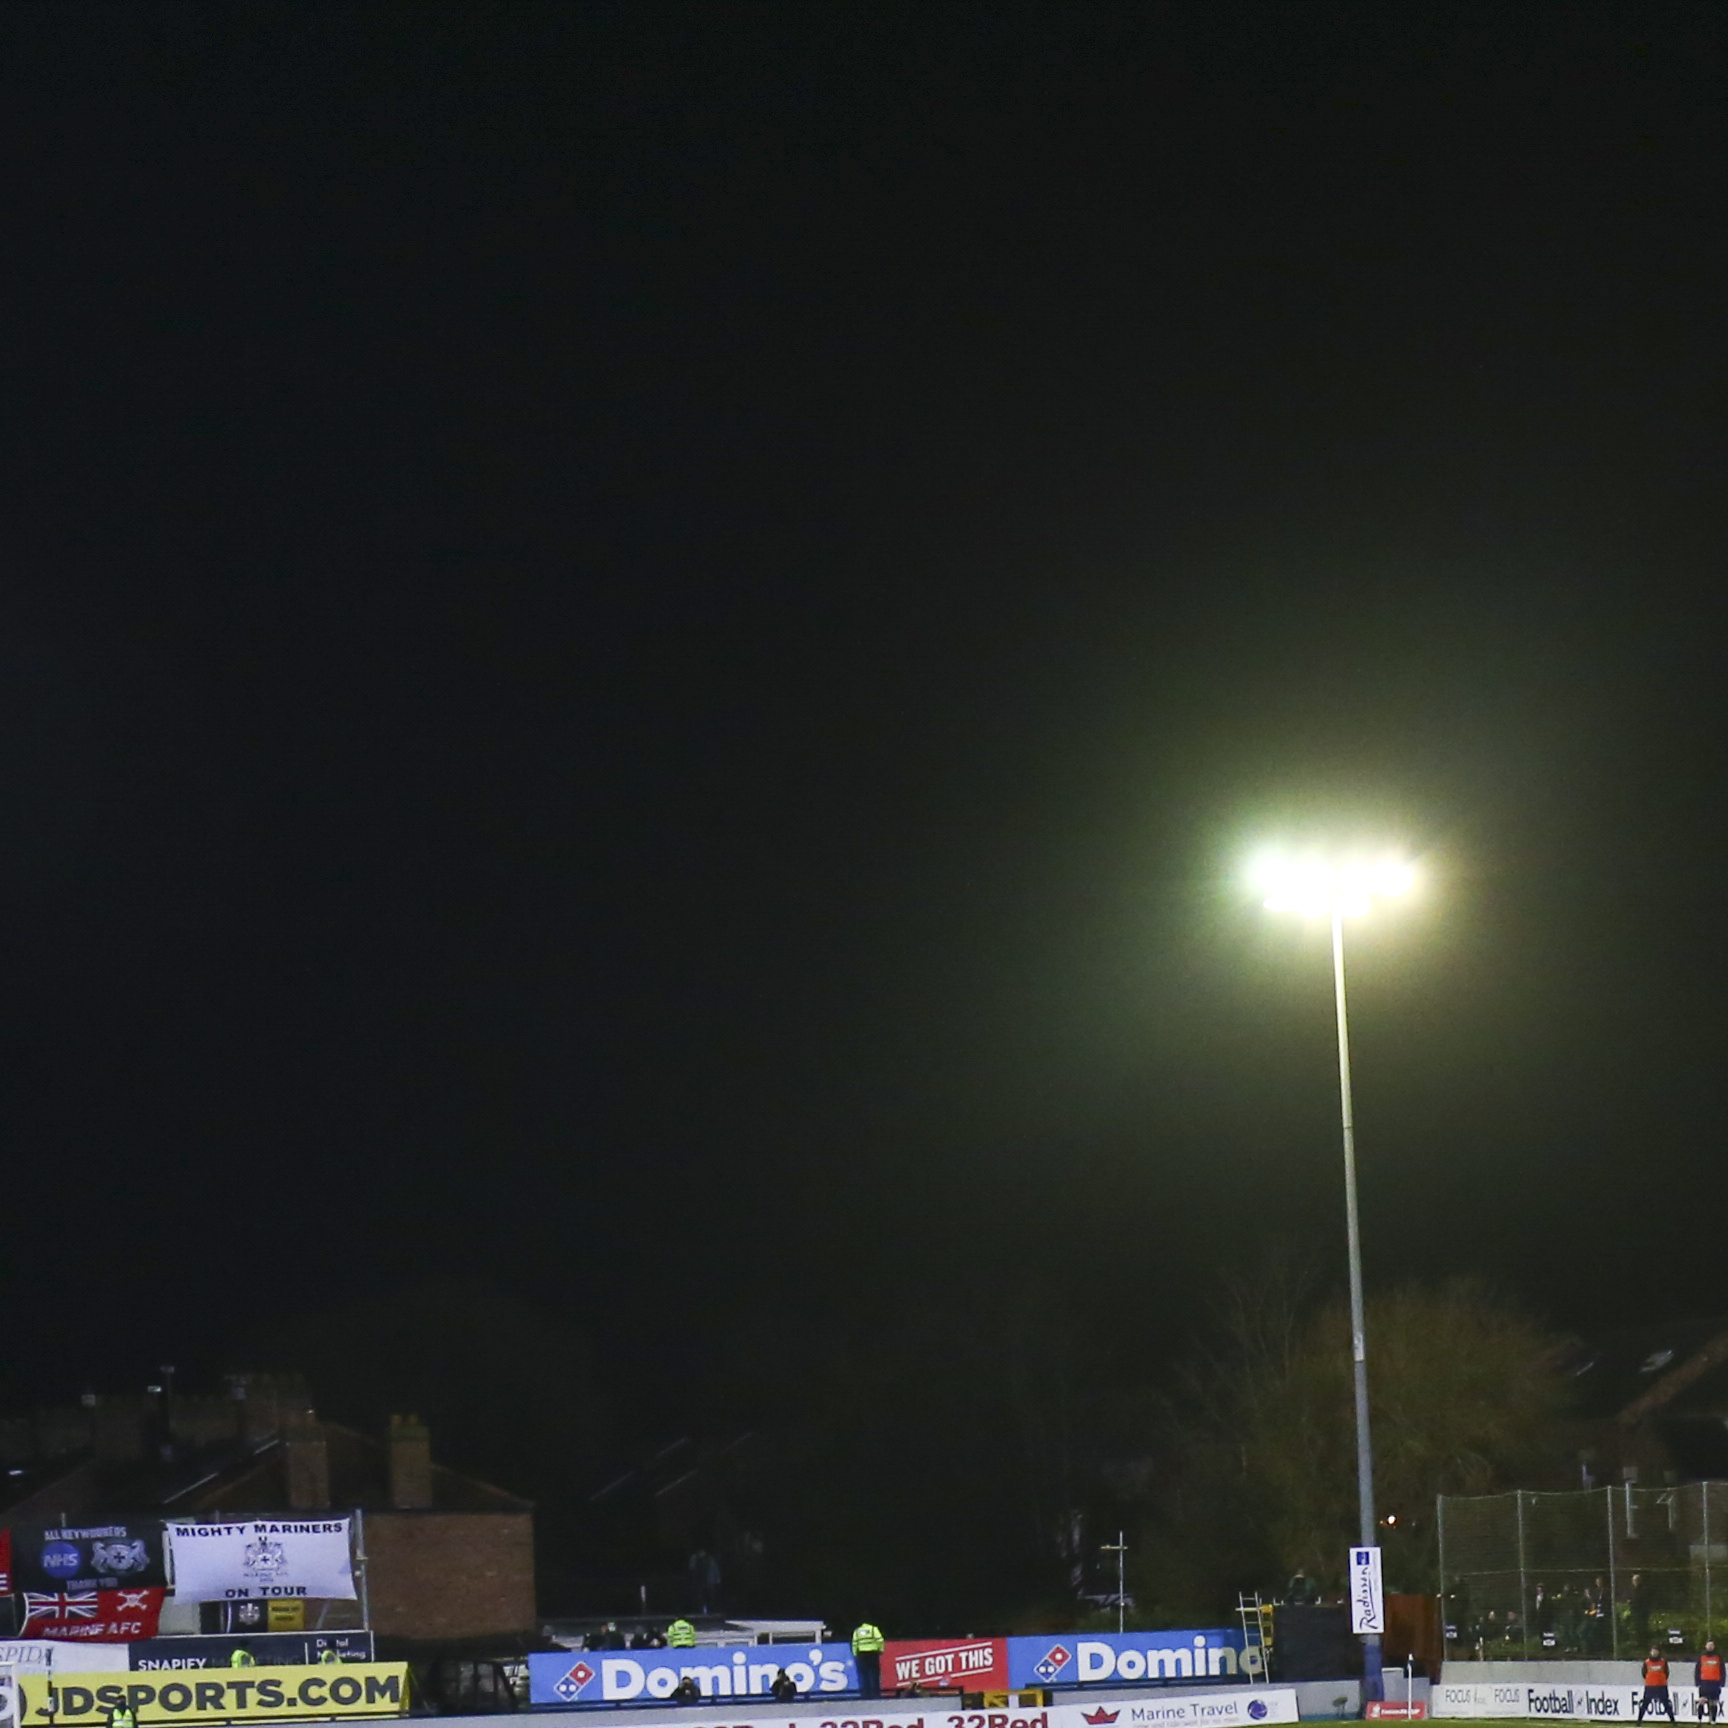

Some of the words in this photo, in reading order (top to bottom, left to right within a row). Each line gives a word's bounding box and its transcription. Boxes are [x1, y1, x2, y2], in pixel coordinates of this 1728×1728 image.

[176, 1526, 246, 1537] MIGHTY
[254, 1522, 343, 1534] MARINERS
[43, 1552, 78, 1567] NHS
[225, 1588, 249, 1598] ON
[261, 1586, 307, 1597] TOUR
[108, 1621, 142, 1635] AFC
[316, 1637, 349, 1648] Dital
[138, 1657, 207, 1672] SNAPIFY
[896, 1658, 920, 1681] WE
[925, 1654, 955, 1675] GOT
[958, 1648, 993, 1671] THIS
[602, 1649, 849, 1700] Domino's
[35, 1675, 400, 1718] JDSPORTS.COM
[1445, 1690, 1471, 1704] FOCUS
[1495, 1688, 1521, 1703] FOCUS
[1528, 1689, 1574, 1715] Football
[1586, 1690, 1620, 1716] Index
[1131, 1705, 1186, 1721] Marine
[1190, 1701, 1239, 1717] Travel
